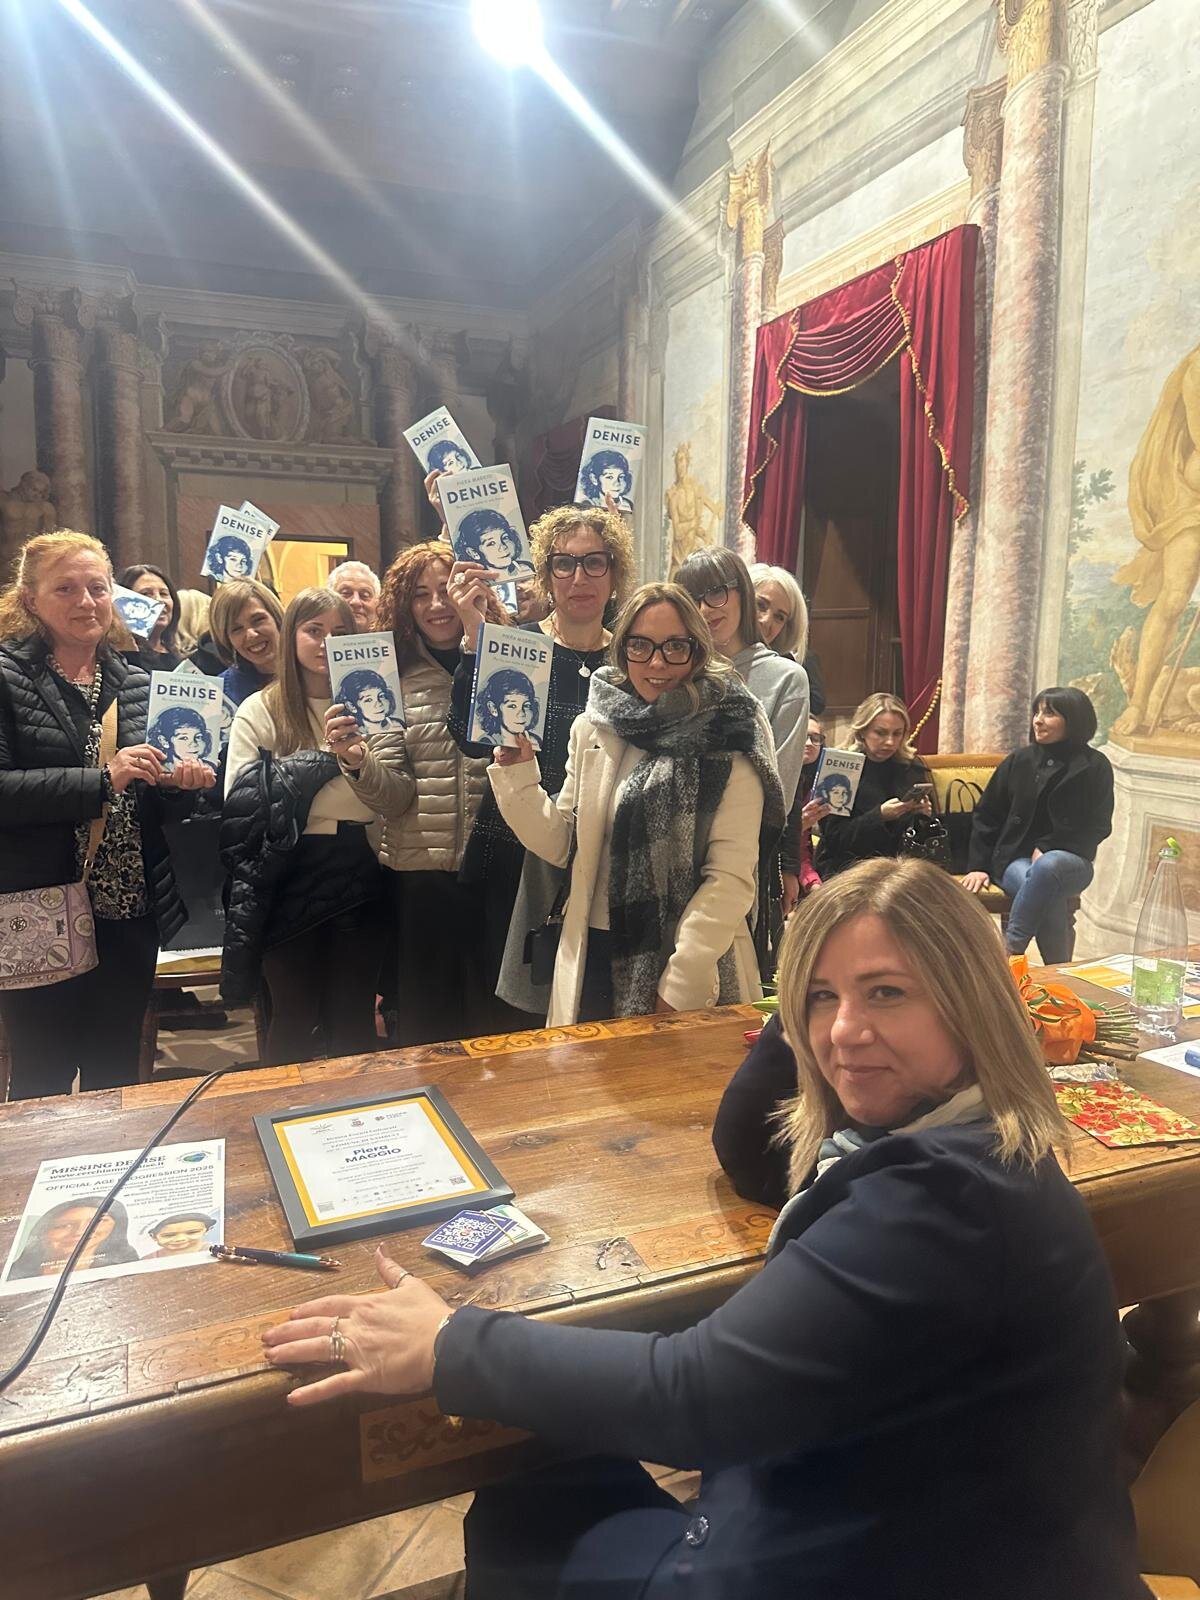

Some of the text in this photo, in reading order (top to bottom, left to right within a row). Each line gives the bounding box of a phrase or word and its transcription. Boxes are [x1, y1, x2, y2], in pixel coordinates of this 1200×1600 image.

[412, 417, 451, 447] DENISE
[592, 429, 641, 447] DENISE
[446, 480, 509, 505] DENISE
[221, 516, 264, 539] DENISE
[332, 646, 390, 662] DENISE
[488, 640, 548, 664] DENISE
[157, 684, 217, 701] DENISE
[826, 758, 861, 771] DENISE
[345, 1148, 402, 1164] MAGGIO
[353, 1144, 388, 1156] Piera
[51, 1155, 167, 1175] MISSING DEISE
[46, 1182, 93, 1191] OFFICIAL
[94, 1178, 115, 1187] AGE
